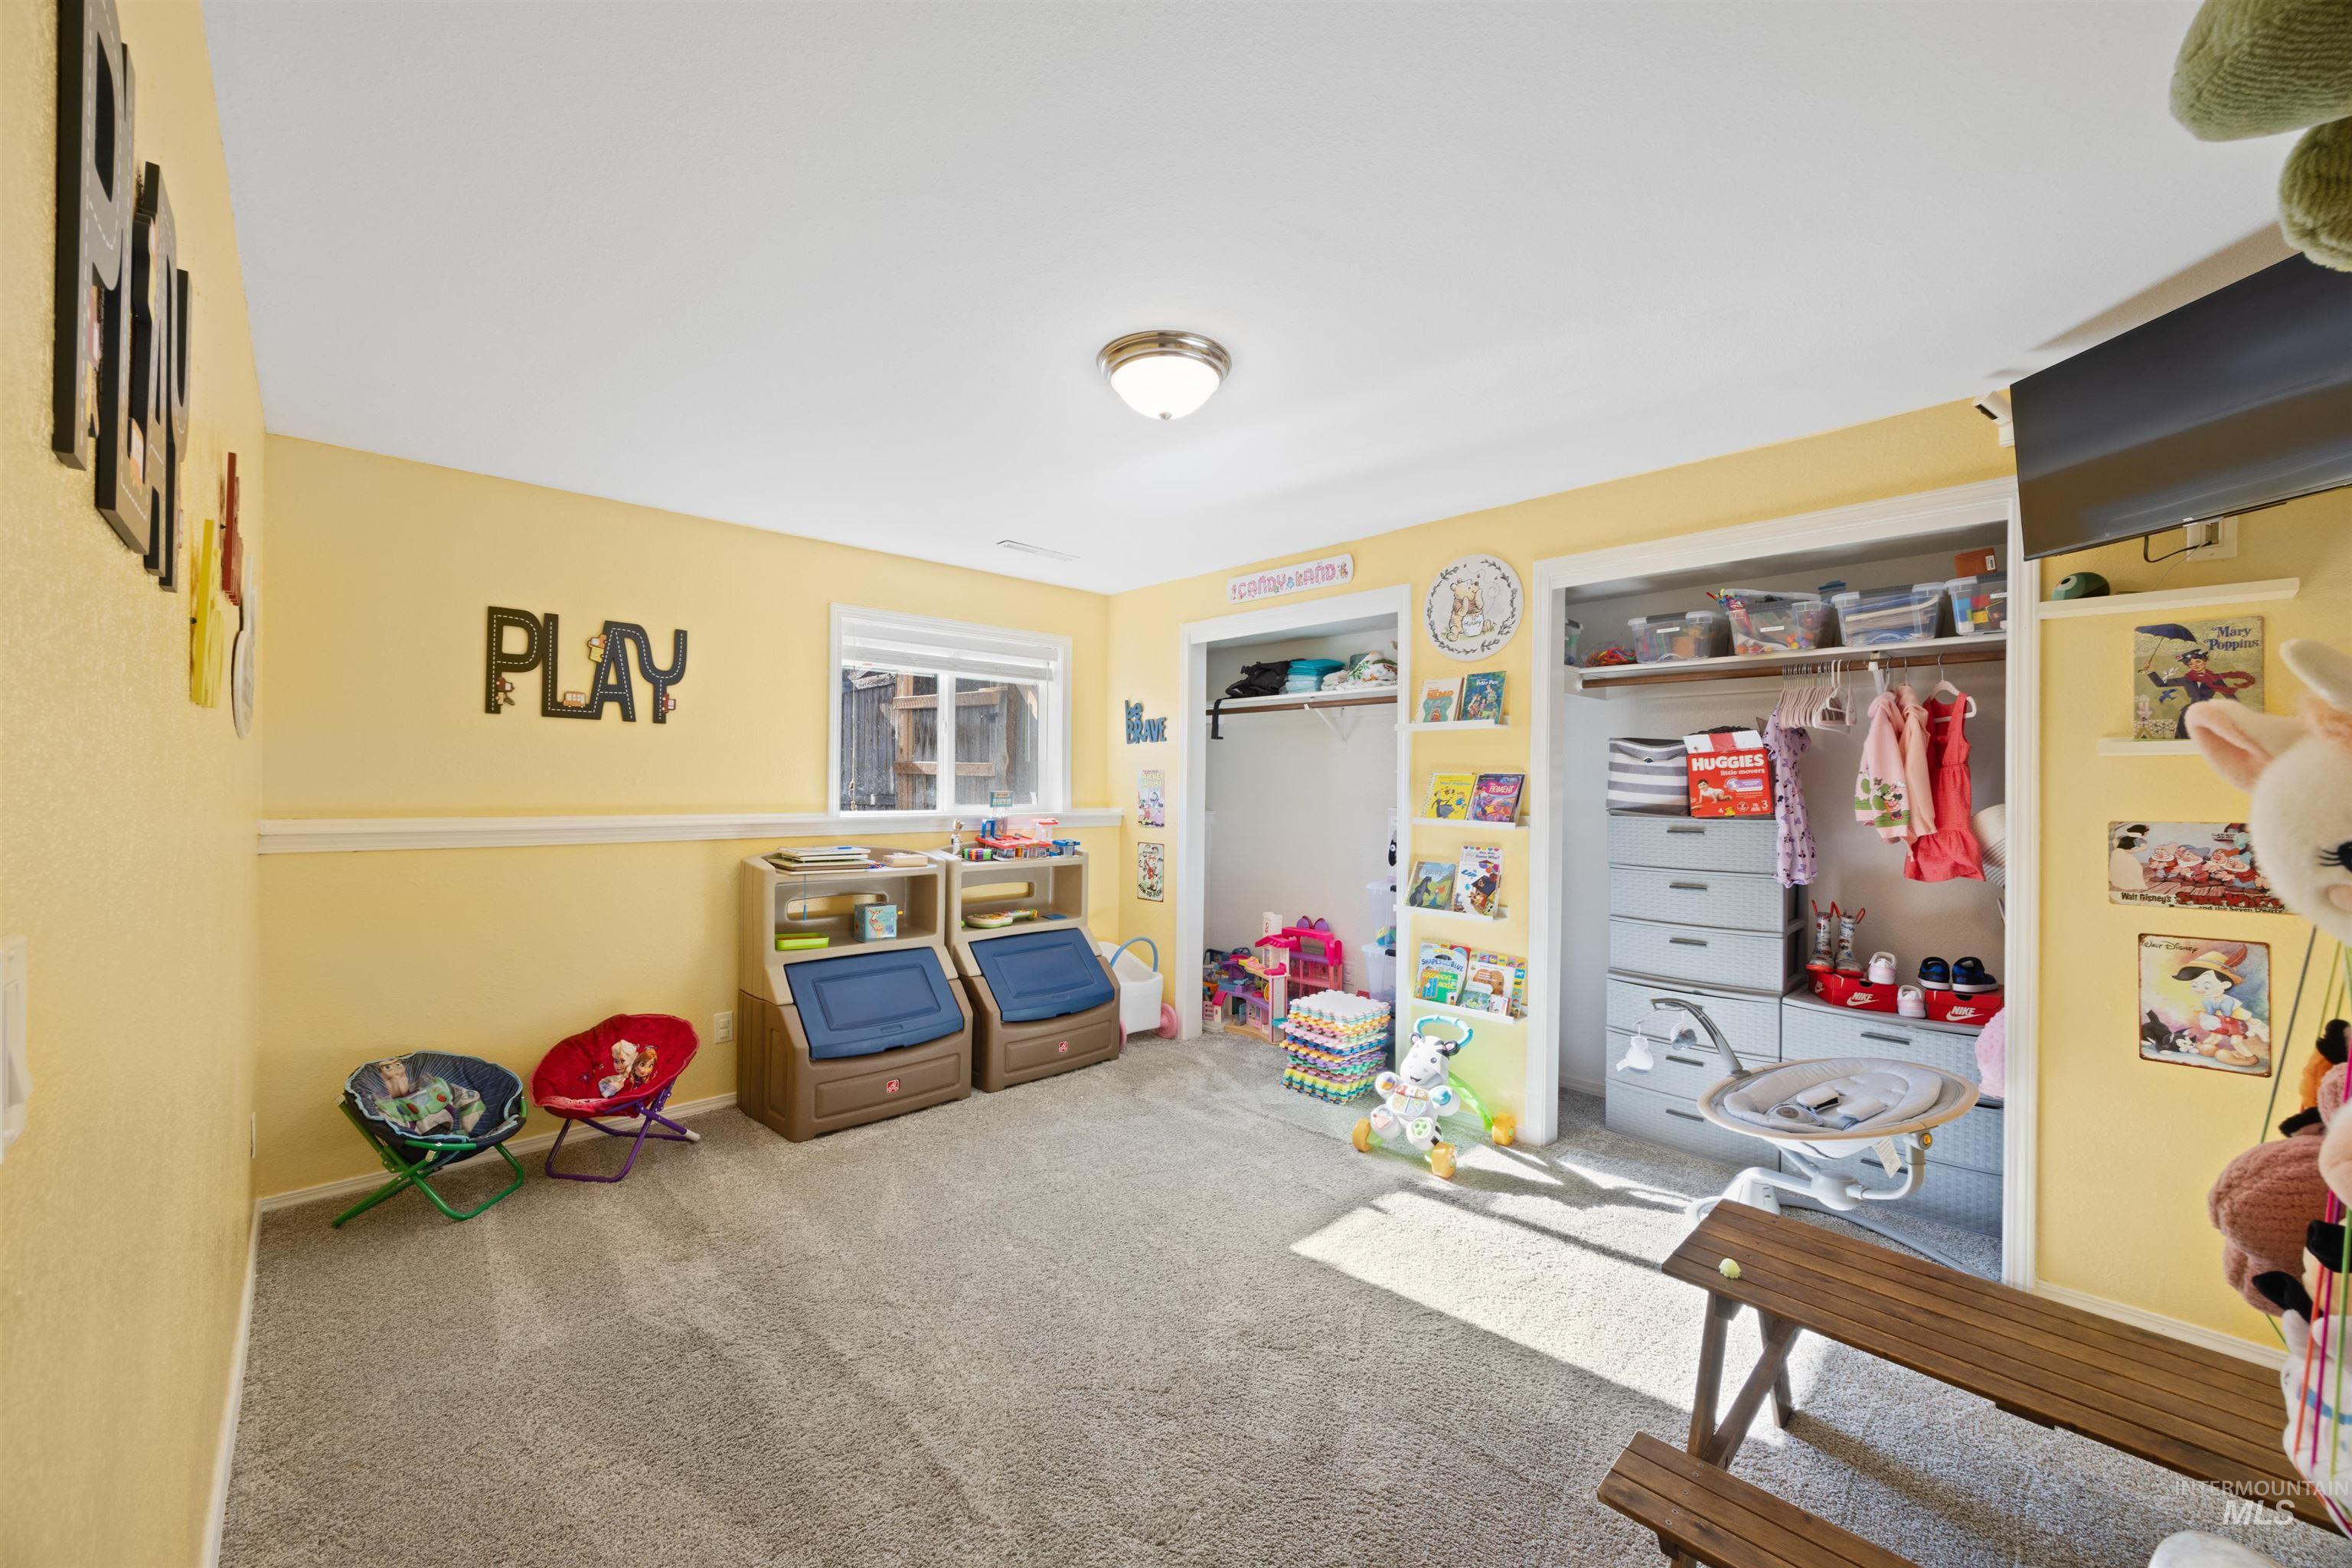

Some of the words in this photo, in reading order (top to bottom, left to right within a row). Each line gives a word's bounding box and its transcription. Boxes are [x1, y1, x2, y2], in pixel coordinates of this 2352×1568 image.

[1238, 573, 1286, 599] CANDY
[1295, 564, 1336, 587] LAND
[2211, 626, 2252, 638] Mary
[2203, 639, 2259, 652] Poppins
[485, 606, 688, 724] PLAY
[1427, 690, 1454, 699] NEMO
[1125, 700, 1144, 720] be
[1125, 717, 1168, 744] BRAVE
[1690, 754, 1764, 771] HUGGIES
[1761, 800, 1768, 808] 3
[2122, 892, 2138, 900] Walt
[1450, 961, 1464, 972] BLUE
[1852, 991, 1874, 1001] NIKE
[1951, 1005, 1976, 1016] NIKE
